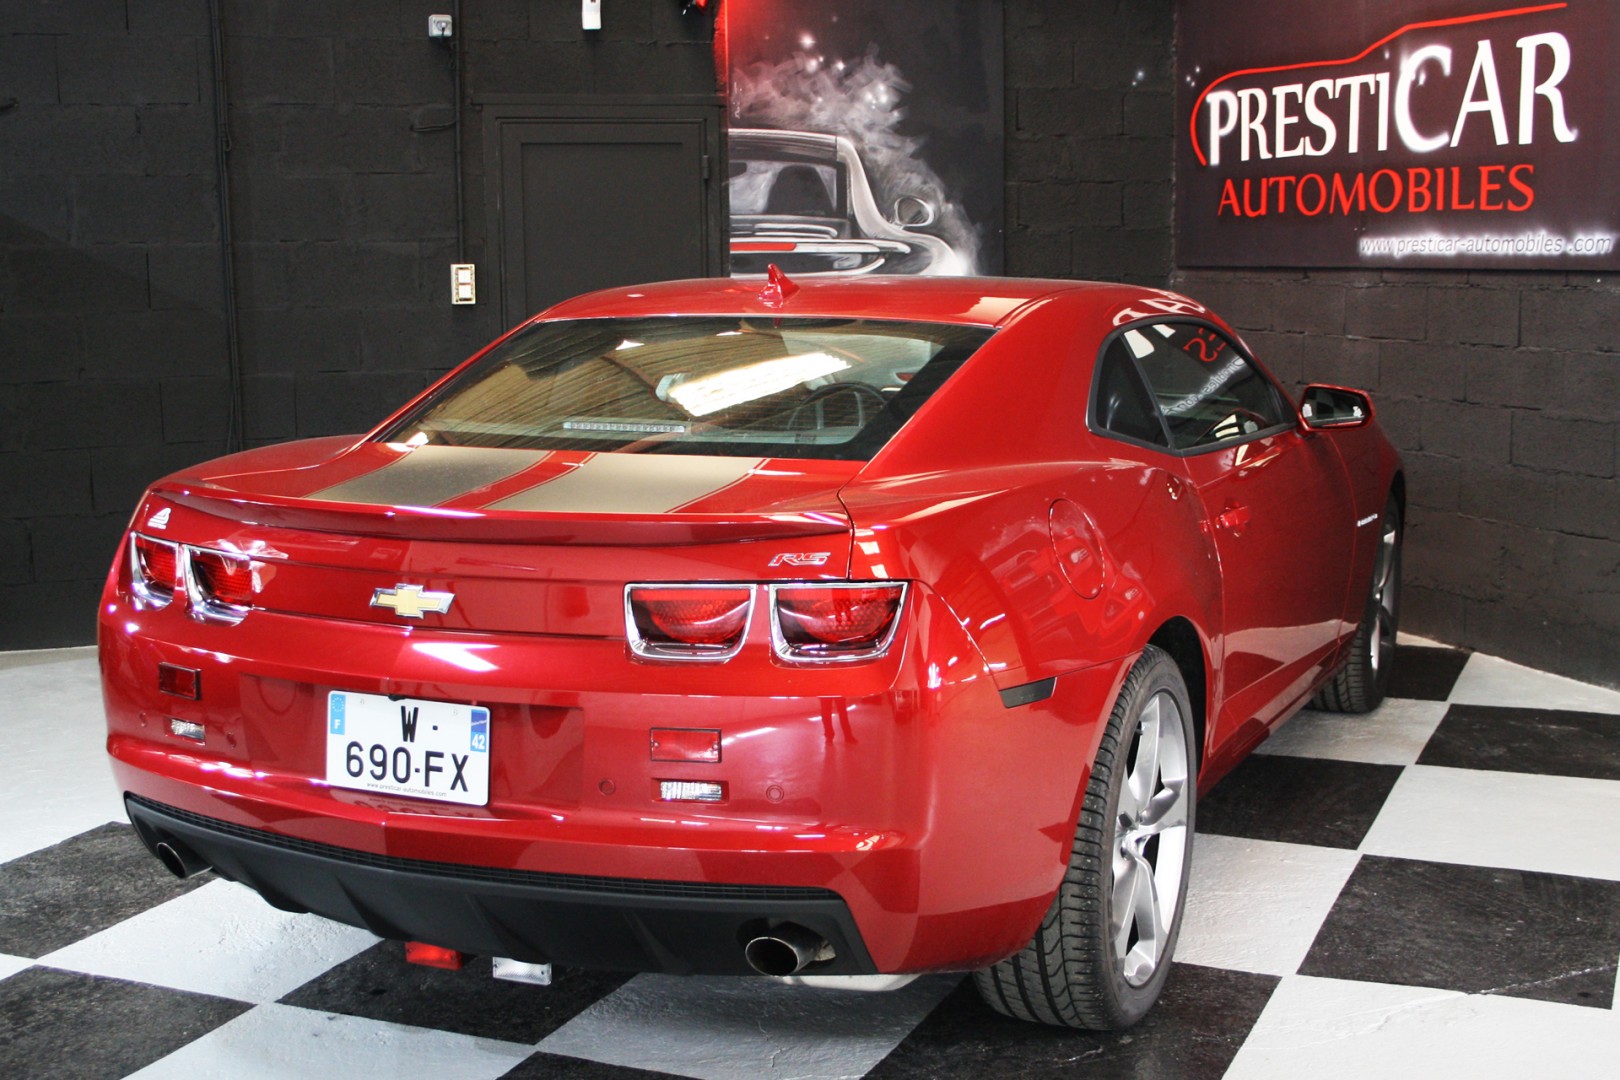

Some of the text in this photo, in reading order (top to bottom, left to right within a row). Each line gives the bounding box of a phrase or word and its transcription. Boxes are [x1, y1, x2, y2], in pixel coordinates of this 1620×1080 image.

[1205, 31, 1578, 165] PRESTICAR
[1218, 163, 1535, 217] AUTOMOBILES
[768, 552, 831, 567] RS
[334, 719, 341, 730] F
[472, 733, 485, 750] 42
